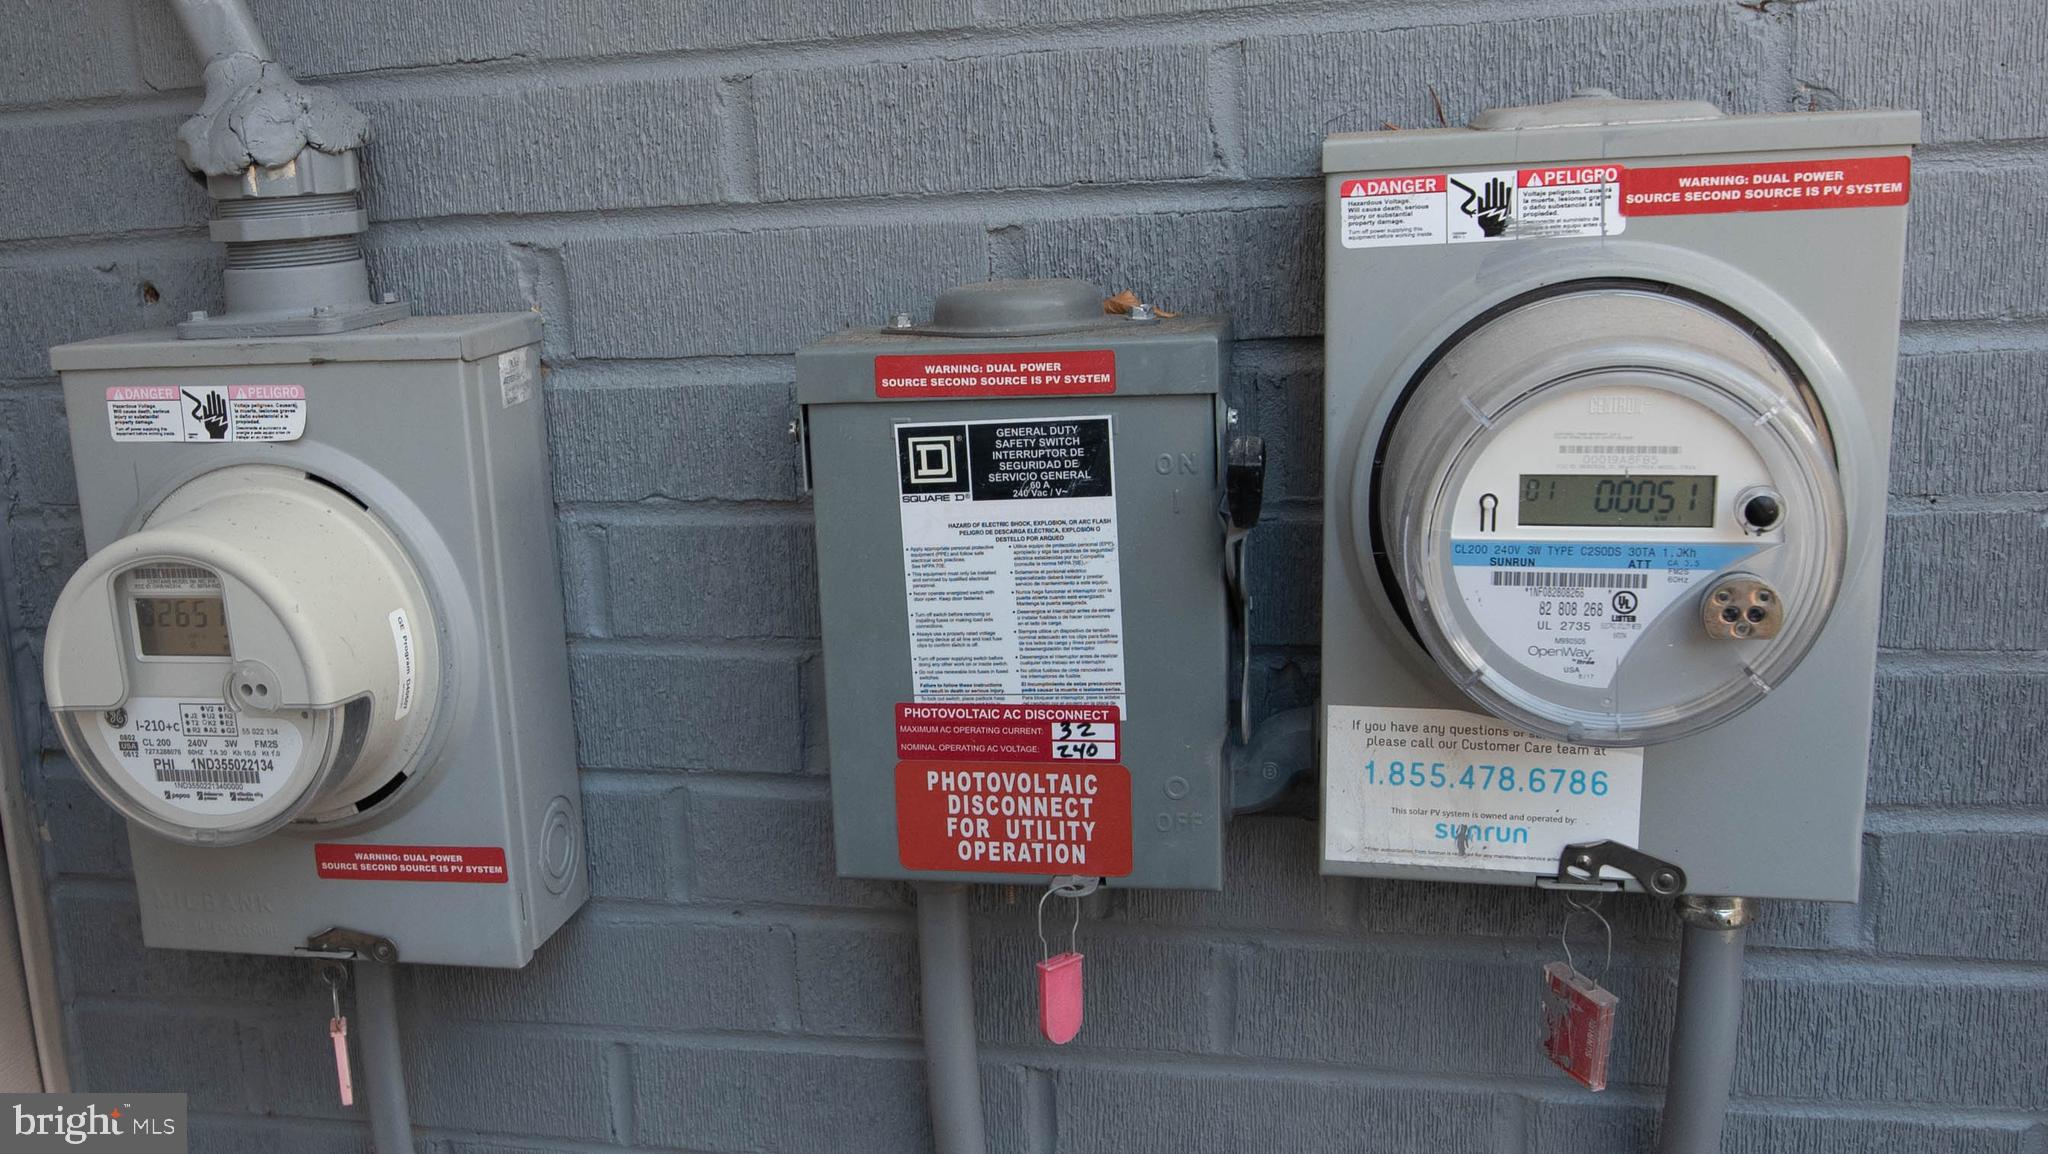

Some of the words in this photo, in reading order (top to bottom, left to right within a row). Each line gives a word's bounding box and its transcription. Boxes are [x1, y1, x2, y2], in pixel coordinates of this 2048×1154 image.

[1544, 168, 1618, 185] PELIGRO
[1678, 177, 1749, 188] WARNING:
[1752, 174, 1790, 185] DUAL
[1794, 171, 1844, 182] POWER
[1368, 180, 1437, 196] DANGER
[1626, 193, 1680, 204] SOURCE
[1684, 191, 1741, 202] SECOND
[1745, 188, 1802, 199] SOURCE
[1806, 186, 1820, 197] IS
[1823, 186, 1842, 196] PV
[1846, 182, 1902, 195] SYSTEM
[925, 365, 983, 374] WARNING:
[986, 363, 1017, 373] DUAL
[1020, 362, 1061, 372] POWER
[882, 378, 927, 387] SOURCE
[930, 377, 977, 387] SECOND
[980, 376, 1028, 386] SOURCE
[1031, 375, 1042, 385] IS
[1045, 375, 1060, 384] PV
[1064, 374, 1110, 384] SYSTEM
[126, 387, 173, 400] DANGER
[249, 387, 299, 399] PELIGRO
[996, 427, 1047, 438] GENERAL
[1049, 425, 1078, 436] DUTY
[995, 439, 1036, 449] SAFETY
[1038, 437, 1080, 447] SWITCH
[916, 443, 949, 476] D
[992, 449, 1066, 460] INTERRUPTOR
[1069, 448, 1085, 457] DE
[999, 460, 1061, 471] SEGURIDAD
[1064, 459, 1079, 469] DE
[1156, 451, 1198, 476] ON
[988, 471, 1038, 482] SERVICIO
[1040, 470, 1091, 481] GENERAL
[1030, 481, 1041, 490] 60
[1043, 480, 1051, 489] A
[902, 493, 951, 503] SQUARE
[1013, 490, 1029, 498] 240
[1031, 489, 1048, 497] Vac
[1526, 479, 1556, 501] 01
[1594, 479, 1698, 513] 00051
[981, 521, 1009, 529] ELECTRIC
[1092, 517, 1111, 525] FLASH
[958, 529, 984, 537] PELIGRO
[994, 528, 1026, 536] DESCARGA
[995, 535, 1025, 543] DESTELLO
[1039, 534, 1064, 542] ARQUEO
[1454, 545, 1488, 555] CL200
[1494, 545, 1521, 555] 240V
[1527, 546, 1541, 555] 3W
[1548, 546, 1574, 556] TYPE
[1490, 558, 1536, 567] SUNRUN
[1628, 560, 1652, 569] ATT
[1539, 601, 1552, 616] 82
[1558, 602, 1577, 616] 808
[1583, 602, 1603, 617] 268
[1537, 621, 1552, 630] UL
[1560, 621, 1591, 631] 2735
[1528, 645, 1592, 658] OpenWay
[1563, 666, 1580, 674] USA
[904, 707, 1000, 719] PHOTOVOLTAIC
[1003, 709, 1020, 720] AC
[1025, 710, 1109, 721] DISCONNECT
[900, 725, 939, 733] MAXIMUM
[940, 726, 951, 734] AC
[953, 726, 1000, 735] OPERATING
[1002, 727, 1044, 735] CURRENT:
[1059, 720, 1096, 741] 32
[1352, 719, 1361, 731] If
[1364, 721, 1387, 734] you
[1390, 721, 1419, 734] have
[1422, 723, 1446, 737] any
[1449, 724, 1510, 739] questions
[142, 739, 154, 747] CL
[156, 739, 171, 747] 200
[187, 739, 208, 748] 240V
[224, 740, 237, 748] 3W
[254, 740, 279, 749] FM2S
[900, 743, 936, 752] NOMINAL
[938, 743, 986, 752] OPERATING
[987, 744, 998, 752] AC
[1000, 744, 1040, 753] VOLTAGE:
[1366, 735, 1407, 749] please
[1410, 736, 1434, 749] call
[1438, 739, 1458, 750] our
[1461, 739, 1521, 753] Customer
[1524, 741, 1553, 754] Care
[1557, 744, 1590, 756] team
[1593, 746, 1607, 757] at
[1057, 742, 1099, 760] 240
[153, 758, 175, 770] PHI
[191, 758, 274, 771] 1ND355022134
[927, 771, 1098, 795] PHOTOVOLTAIC
[1364, 760, 1610, 797] 1.855.478.6786
[948, 794, 1093, 818] DISCONNECT
[1391, 806, 1408, 815] This
[1409, 807, 1429, 816] solar
[1430, 808, 1441, 817] PV
[1442, 810, 1470, 820] system
[1472, 810, 1479, 819] is
[1480, 812, 1507, 821] owned
[1509, 811, 1525, 821] and
[1526, 813, 1563, 825] operated
[1565, 815, 1578, 826] by:
[947, 817, 990, 838] FOR
[1006, 819, 1096, 841] UTILITY
[1434, 821, 1529, 844] sunrun
[354, 852, 401, 861] WARNING:
[403, 854, 428, 862] DUAL
[430, 854, 463, 863] POWER
[958, 840, 1086, 864] OPERATION
[322, 862, 358, 870] SOURCE
[360, 863, 398, 871] SECOND
[400, 864, 437, 872] SOURCE
[439, 865, 449, 873] IS
[451, 865, 463, 873] PV
[465, 866, 503, 874] SYSTEM
